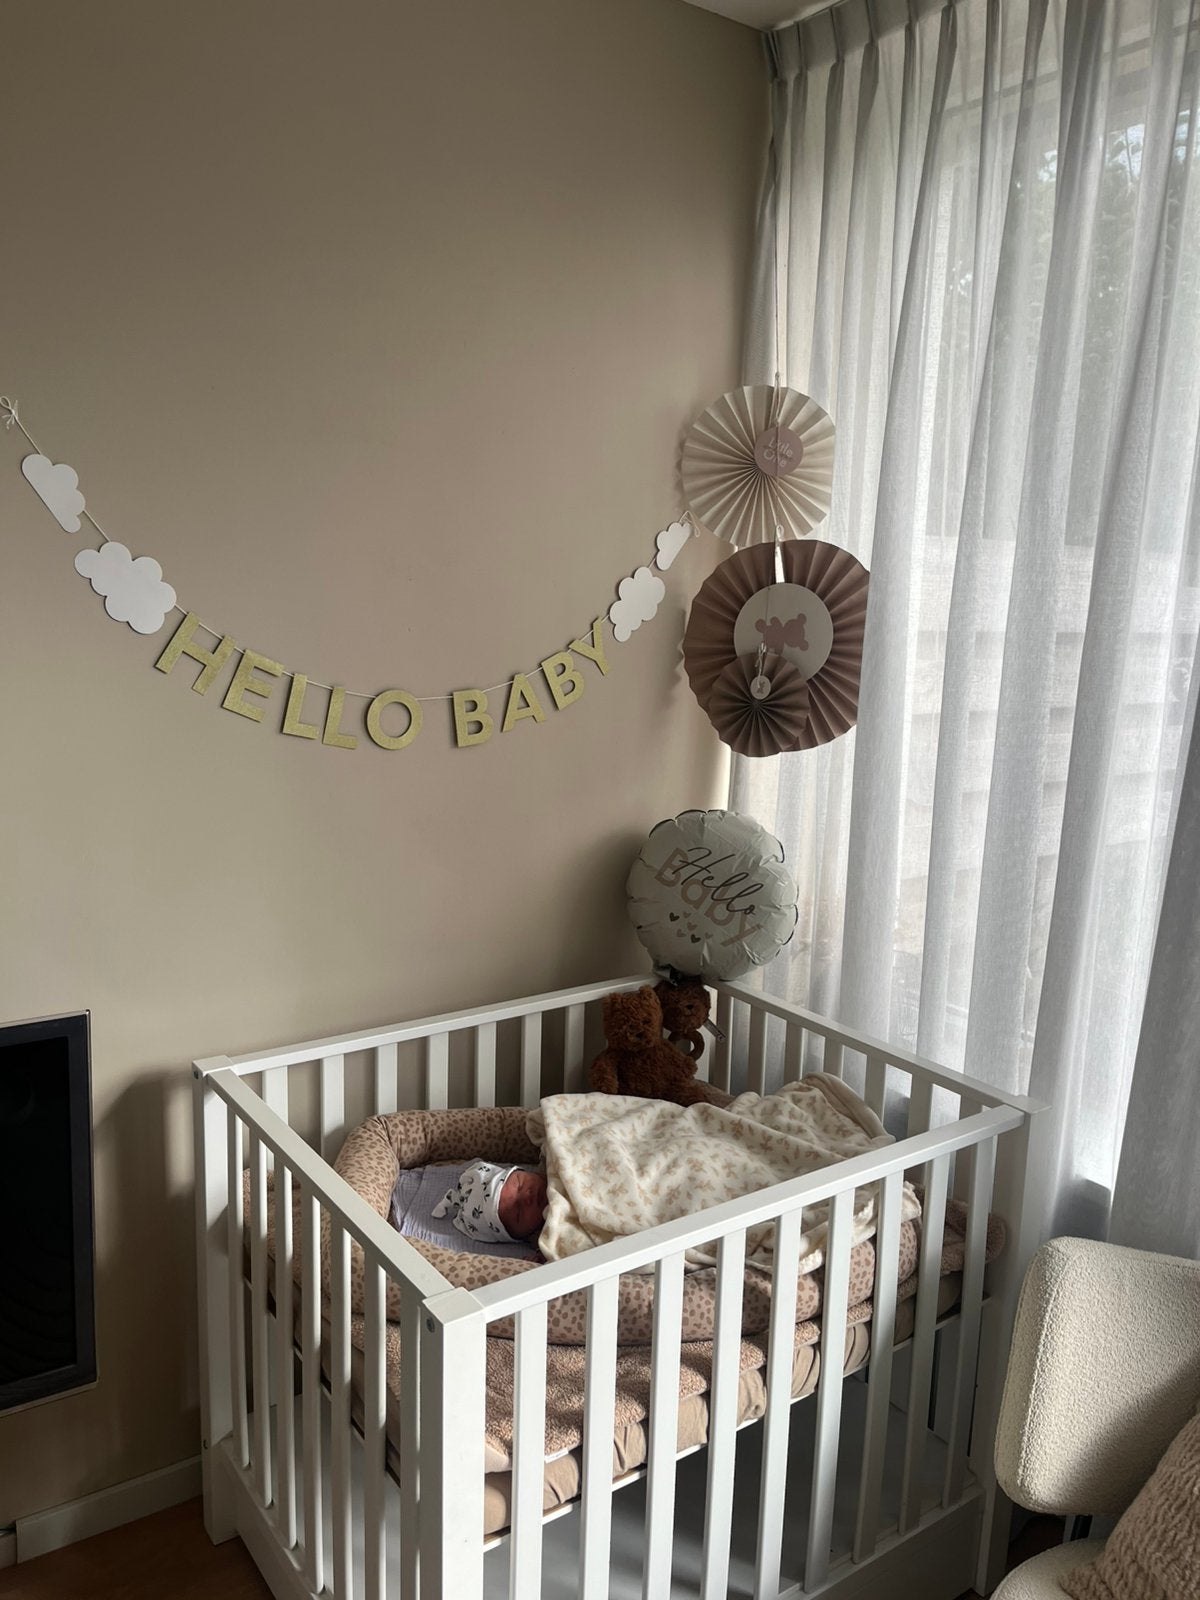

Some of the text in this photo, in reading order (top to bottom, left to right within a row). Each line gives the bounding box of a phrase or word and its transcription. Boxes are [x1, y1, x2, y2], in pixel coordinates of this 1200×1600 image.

[768, 436, 793, 458] Lttle
[154, 612, 610, 750] HELLO BABY
[672, 847, 764, 916] Hello
